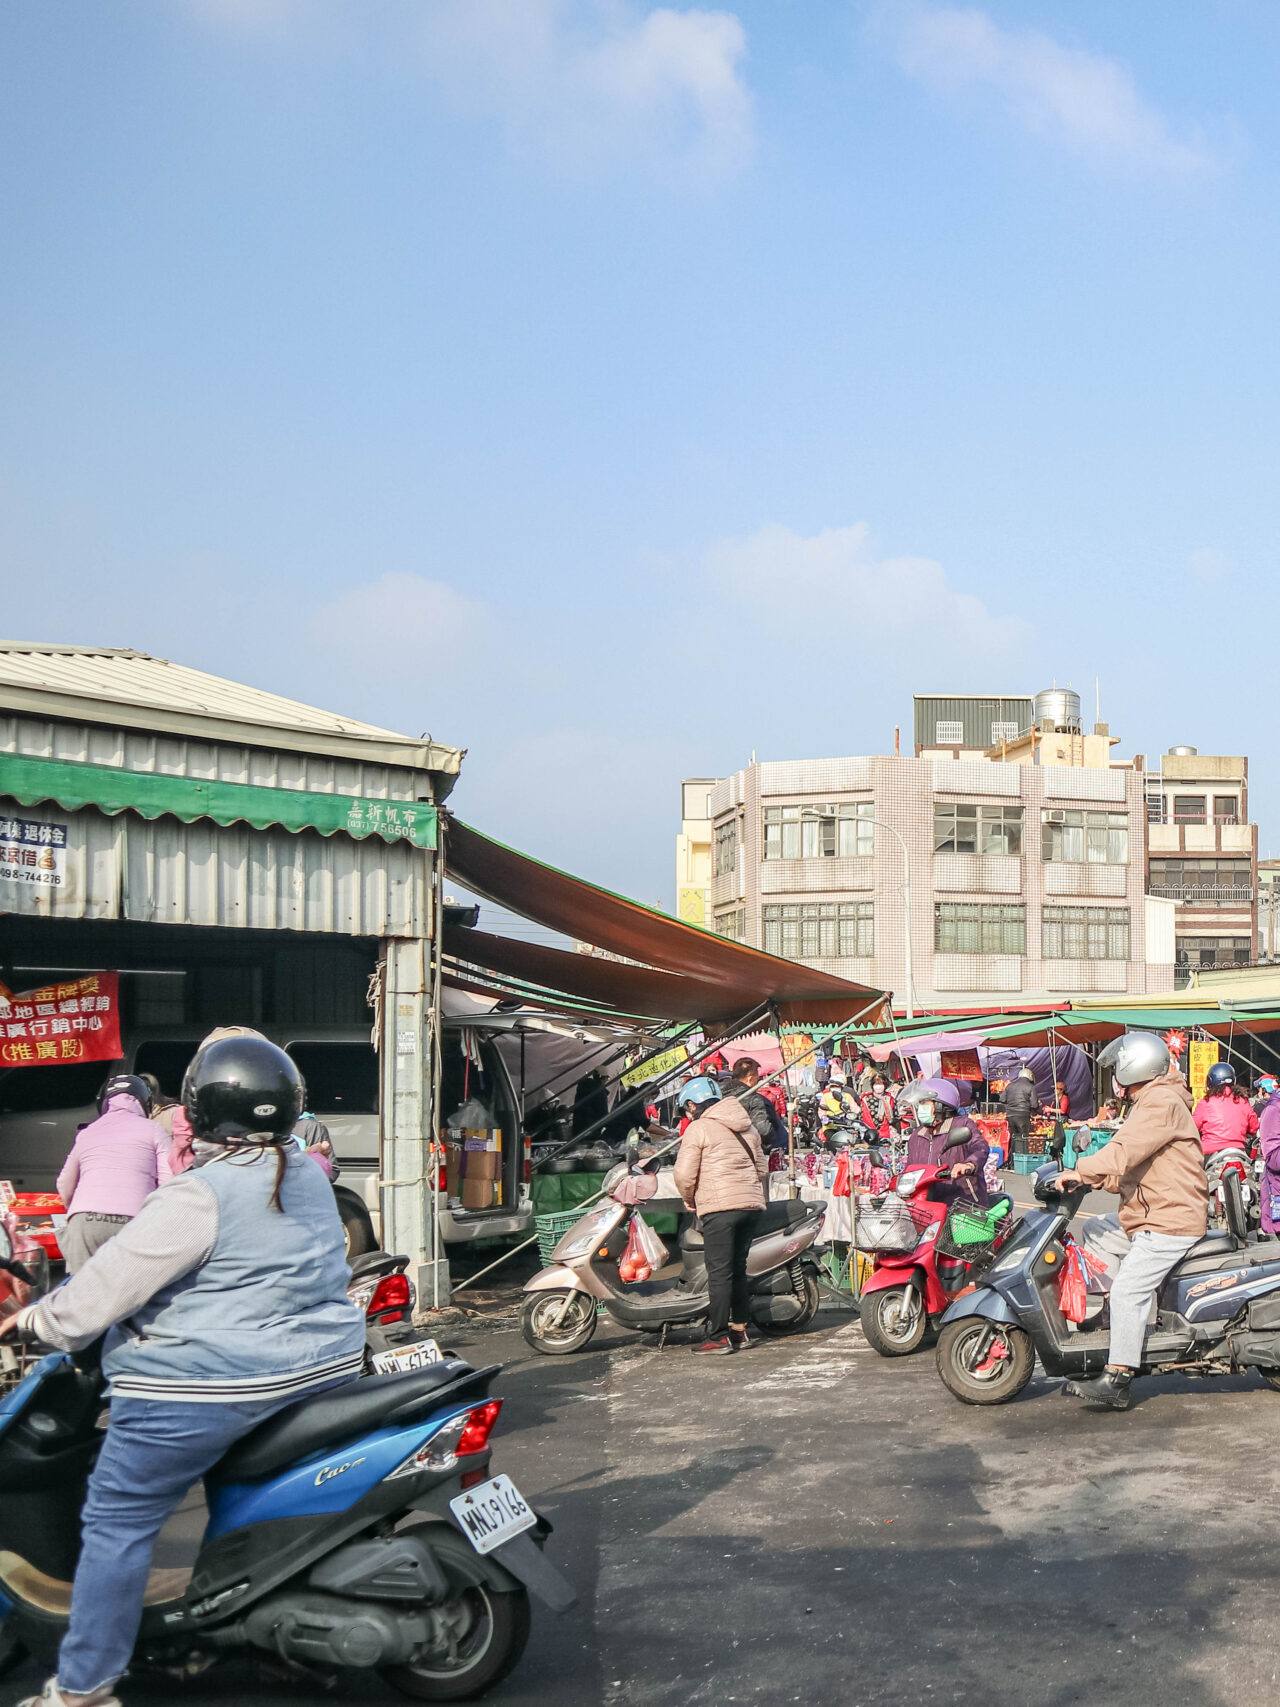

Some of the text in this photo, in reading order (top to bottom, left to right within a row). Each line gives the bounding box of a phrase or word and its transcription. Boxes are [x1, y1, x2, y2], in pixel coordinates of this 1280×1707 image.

[347, 800, 417, 827] 嘉新帆布
[24, 824, 65, 844] 退休金
[11, 976, 99, 1003] 金牌獎
[2, 1039, 84, 1061] (推廣股)
